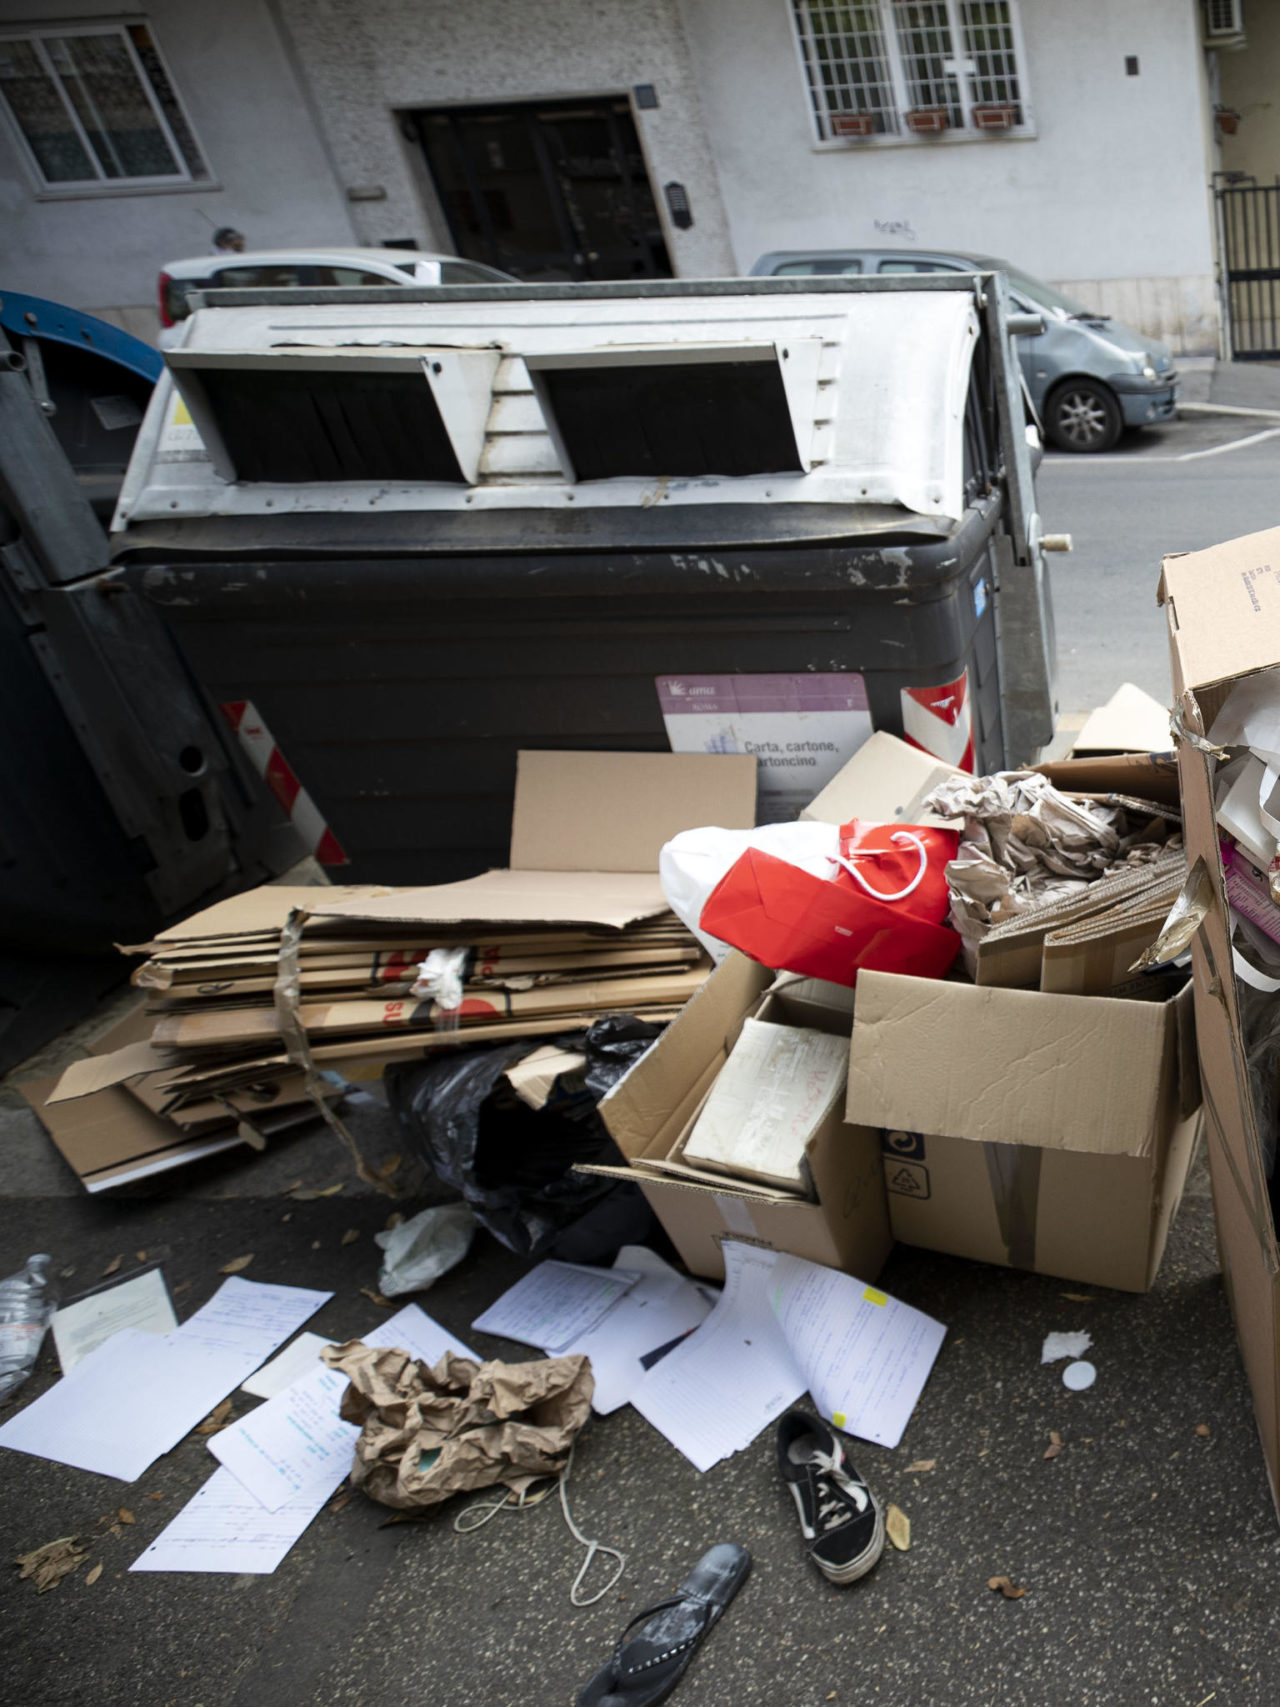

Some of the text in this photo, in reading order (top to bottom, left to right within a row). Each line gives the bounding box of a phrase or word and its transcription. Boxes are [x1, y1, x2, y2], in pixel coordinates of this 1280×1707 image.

[744, 741, 839, 754] Carta, cartone,
[758, 755, 817, 767] artoncino
